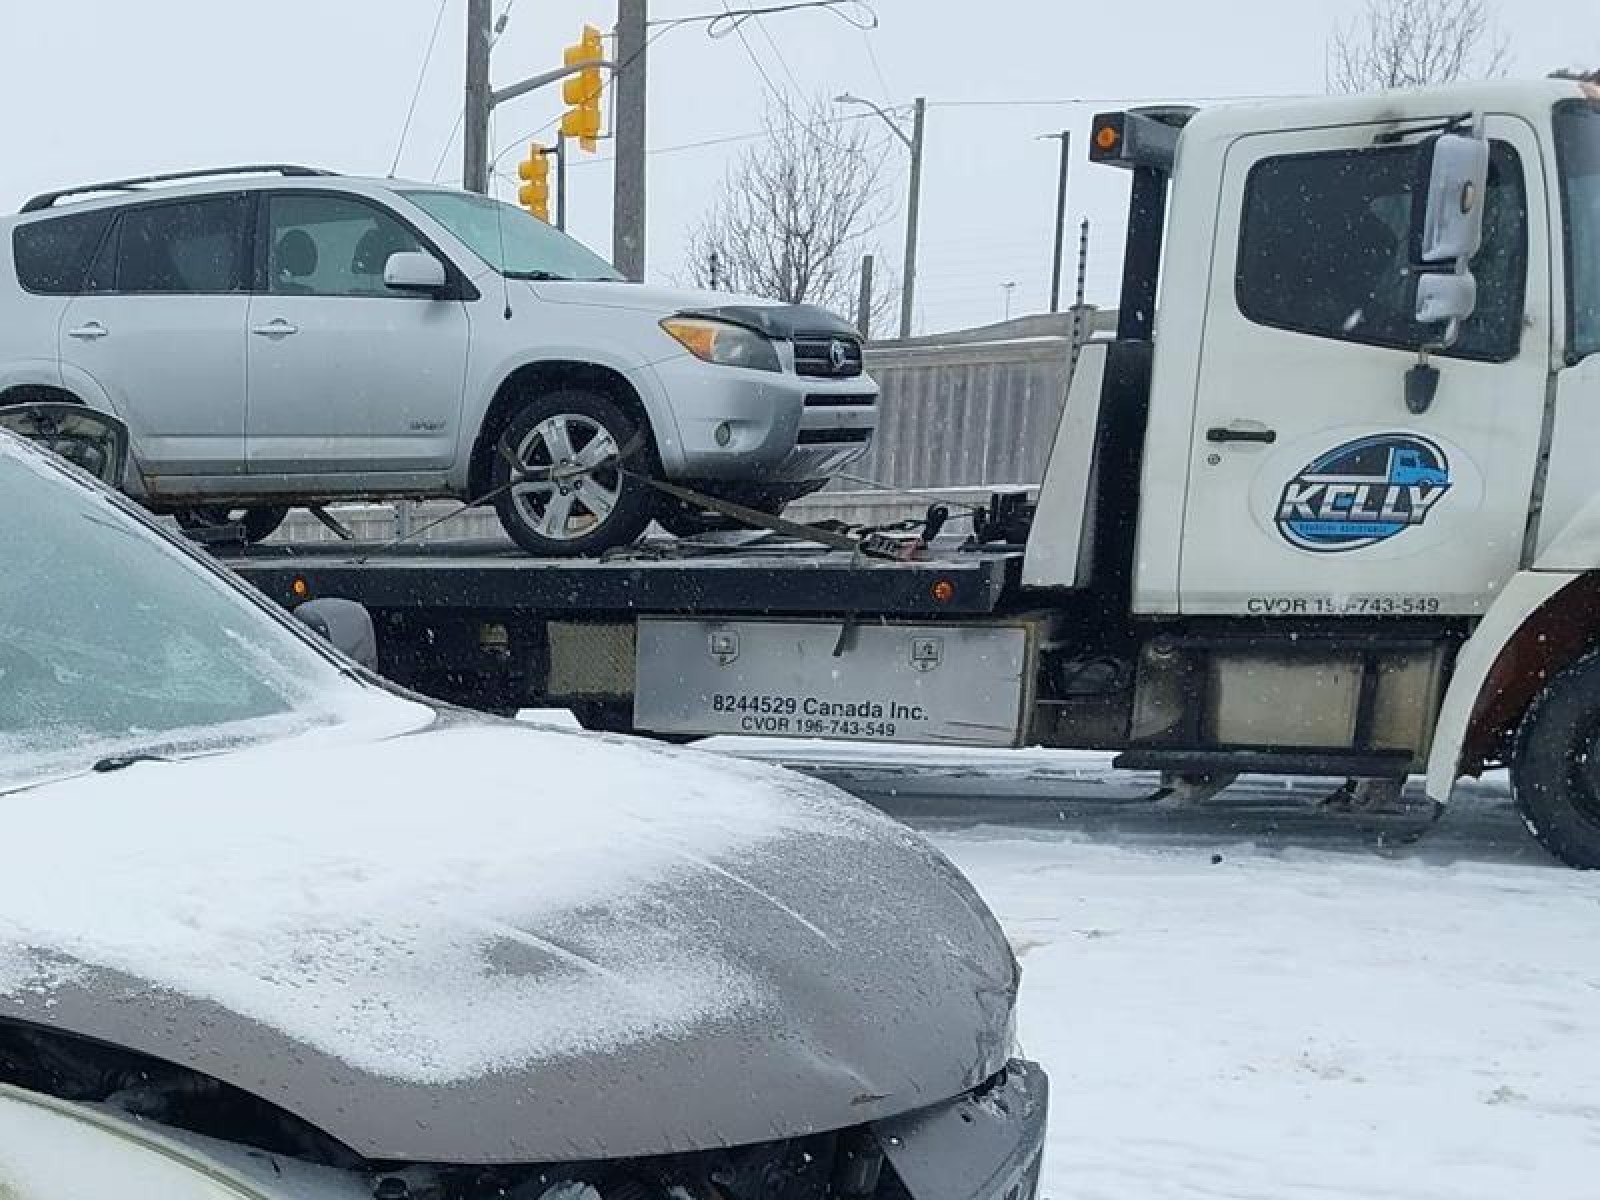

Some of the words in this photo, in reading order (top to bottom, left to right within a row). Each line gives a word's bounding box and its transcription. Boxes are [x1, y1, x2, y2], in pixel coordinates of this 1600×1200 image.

[1279, 483, 1444, 521] KELLY
[1247, 597, 1307, 613] CVOR
[713, 693, 797, 715] 8244529
[803, 697, 884, 719] Canada
[890, 700, 930, 721] Inc.
[740, 714, 790, 732] CVOR
[796, 717, 897, 737] 196-743-549
